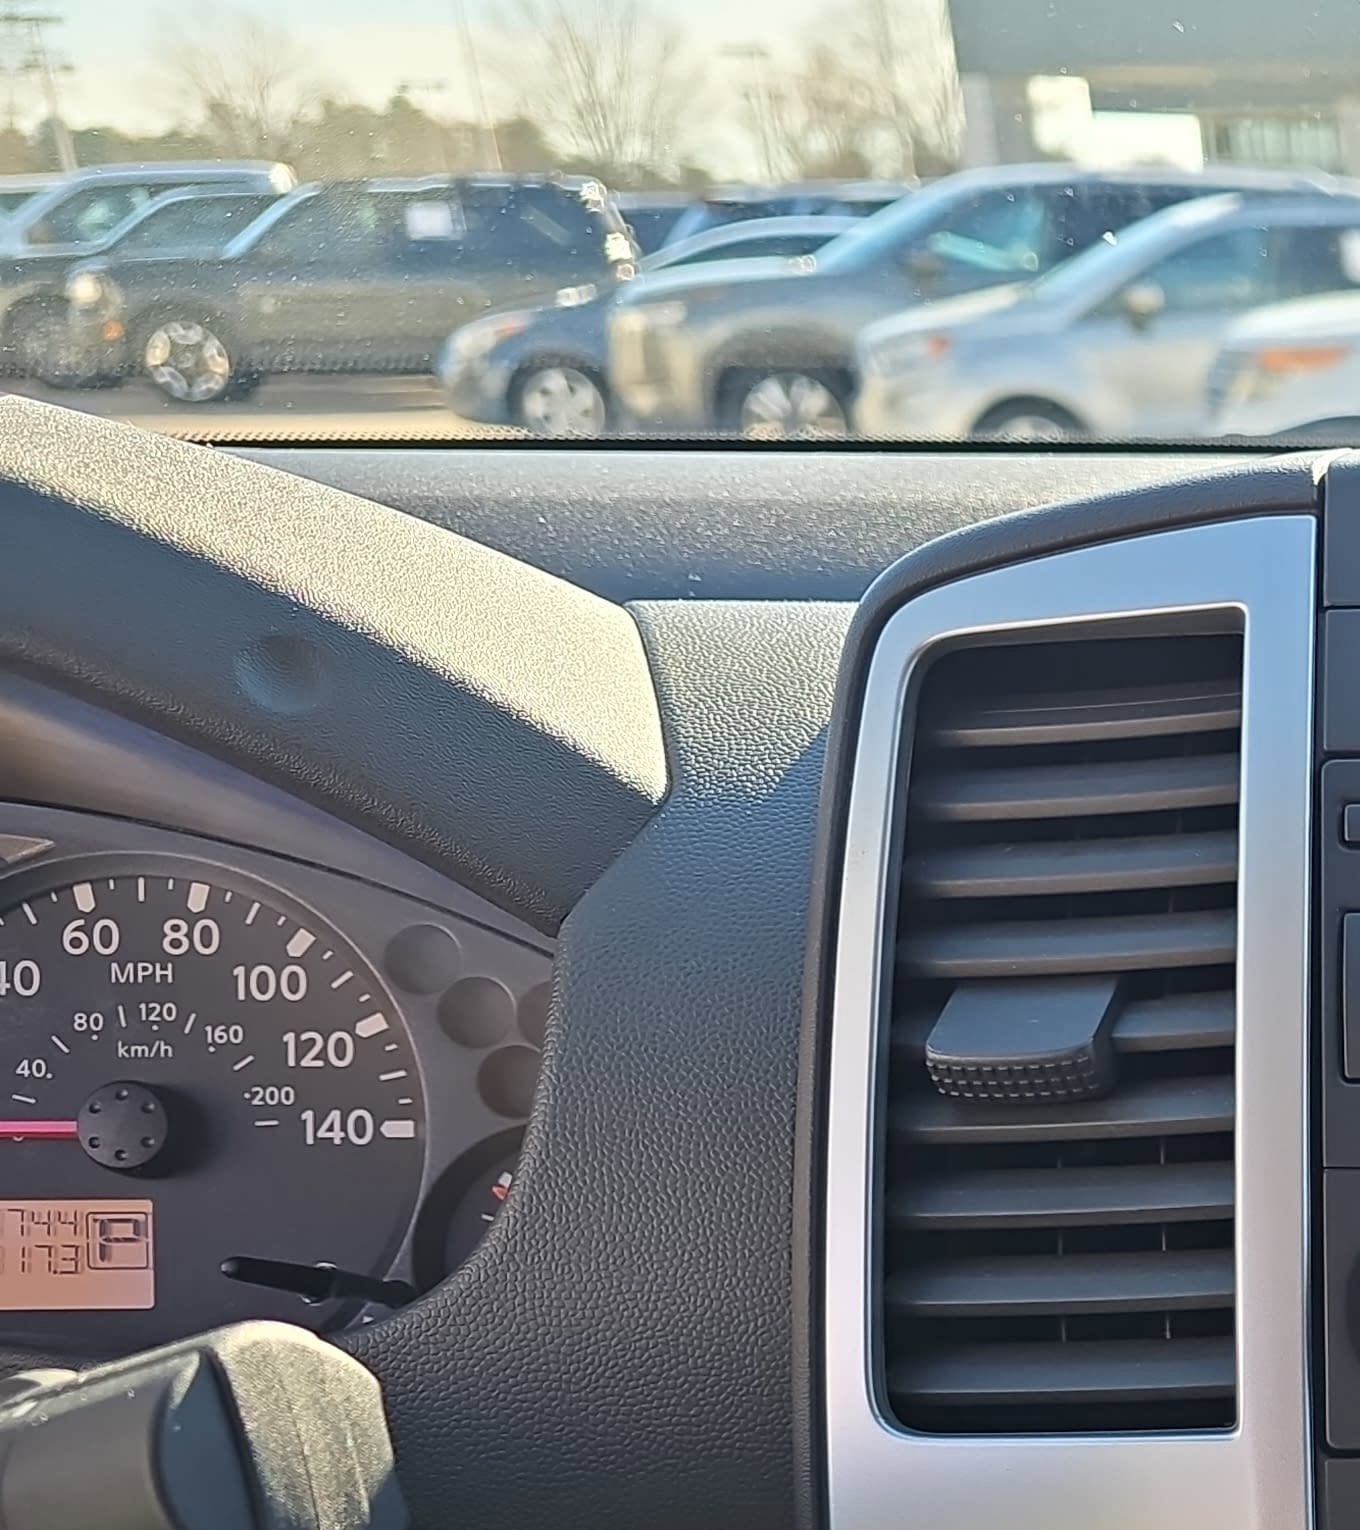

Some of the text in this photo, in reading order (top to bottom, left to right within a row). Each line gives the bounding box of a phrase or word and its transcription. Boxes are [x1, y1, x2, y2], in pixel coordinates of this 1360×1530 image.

[63, 919, 119, 954] 60
[163, 919, 219, 954] 80
[111, 963, 172, 982] MPH
[234, 965, 306, 1000] 100
[140, 1003, 176, 1020] 120
[74, 1013, 103, 1030] 80
[205, 1026, 243, 1043] 160
[118, 1041, 172, 1057] km/h
[283, 1031, 353, 1067] 120
[16, 1060, 45, 1077] 40
[252, 1087, 294, 1105] 200
[302, 1110, 373, 1144] 140
[93, 1218, 140, 1262] P
